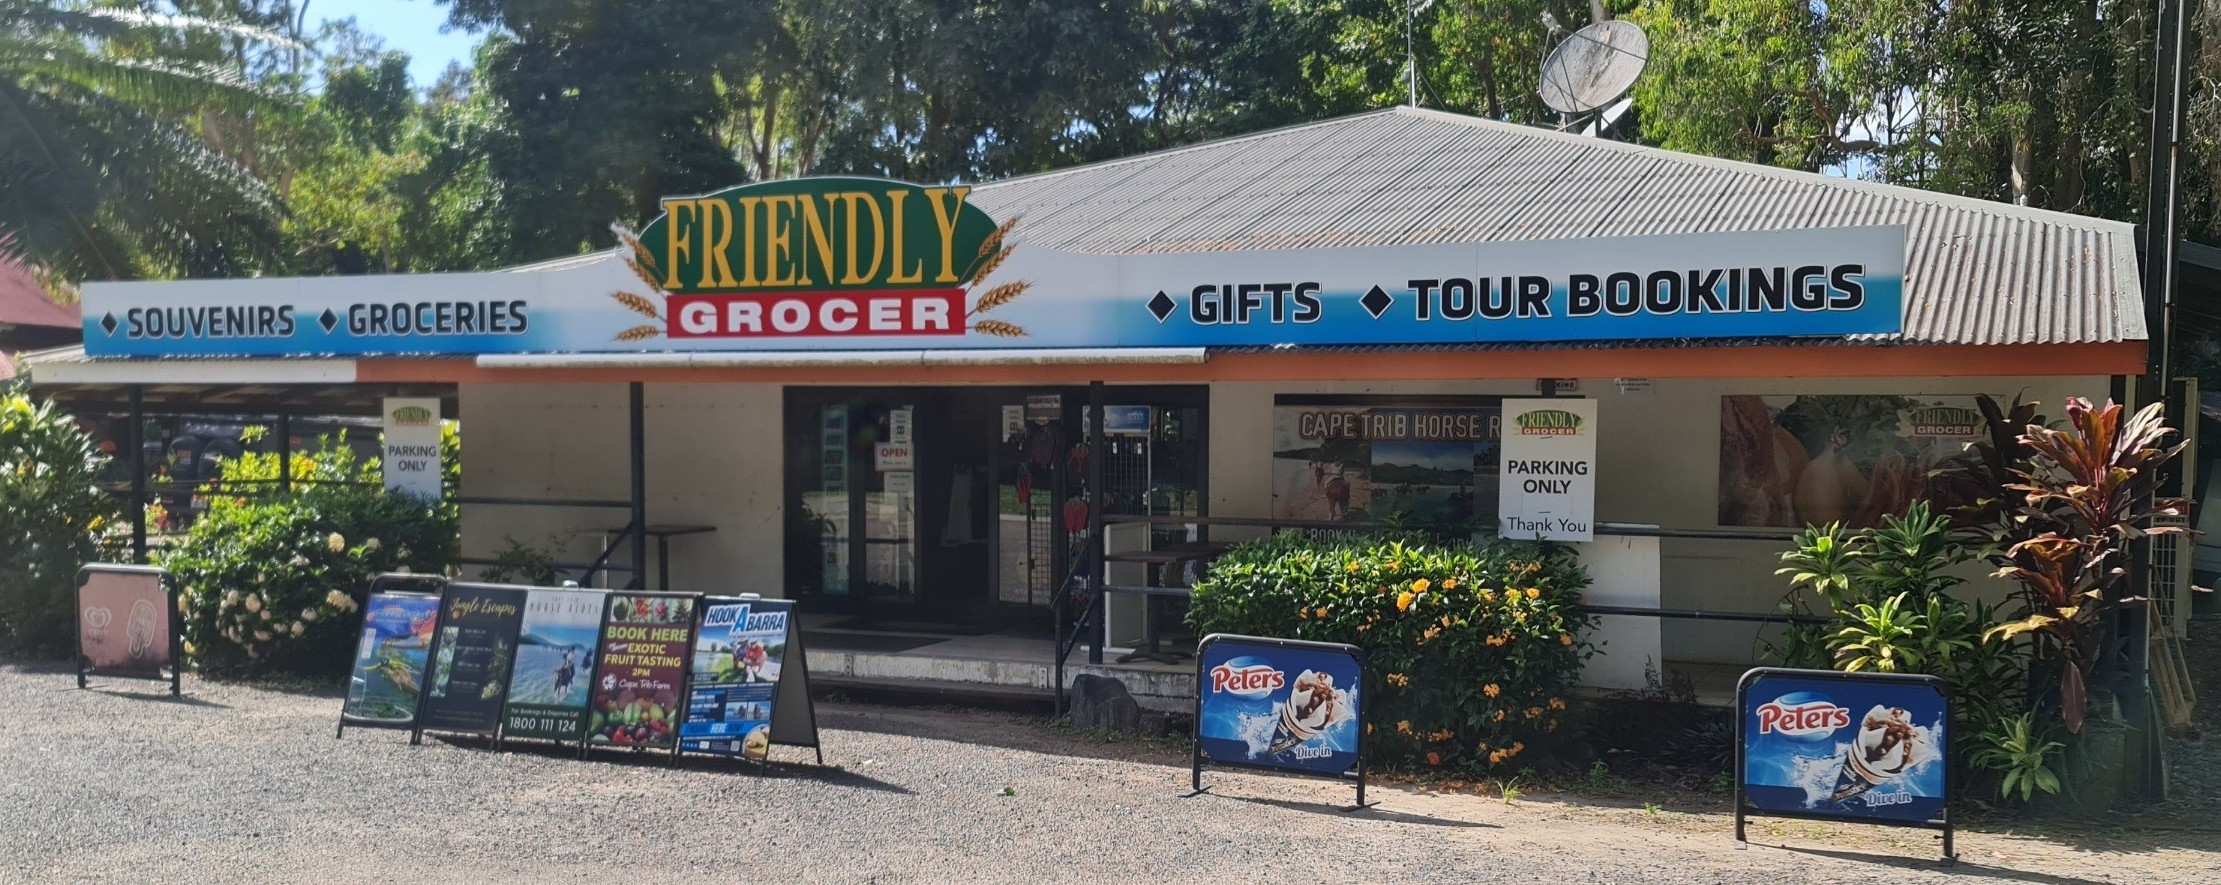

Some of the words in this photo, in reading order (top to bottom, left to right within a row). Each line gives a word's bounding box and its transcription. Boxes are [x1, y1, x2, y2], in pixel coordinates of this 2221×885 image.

[662, 186, 972, 290] FRIENDLY
[1408, 276, 1554, 321] TOUR
[1568, 264, 1866, 317] BOOKINGS
[1190, 281, 1322, 325] GIFTS
[127, 304, 295, 338] SOUVENIRS
[348, 300, 529, 335] GROCERIES
[680, 298, 951, 334] GROCER
[1521, 410, 1578, 428] FRIENDLY
[1915, 408, 1976, 426] FRIENDLY
[1301, 413, 1355, 440] CAPE
[1360, 413, 1407, 440] TRIB
[1413, 413, 1482, 440] HORSE
[1917, 426, 1972, 435] GROCER
[388, 445, 437, 457] PARKING
[881, 448, 908, 457] OPEN
[398, 460, 427, 472] ONLY
[1508, 460, 1588, 475] PARKING
[1523, 479, 1571, 494] ONLY
[1507, 517, 1552, 532] Thank
[1558, 518, 1587, 532] You
[450, 596, 479, 616] Jungle
[481, 598, 518, 618] Escapes
[705, 606, 738, 624] HOOK
[732, 605, 749, 632] A
[746, 613, 786, 632] BARRA
[607, 626, 648, 640] BOOK
[651, 628, 689, 642] HERE
[628, 643, 667, 654] EXOTIC
[604, 654, 636, 666] FRUIT
[637, 655, 681, 667] TASTING
[632, 668, 651, 677] 2PM
[1211, 667, 1285, 692] Peters
[619, 678, 639, 691] Cape
[640, 679, 653, 689] Trib
[653, 680, 671, 690] Farm
[510, 717, 536, 729] 1800
[541, 718, 554, 731] 111
[558, 719, 576, 732] 124
[1757, 704, 1849, 733] Peters
[1296, 746, 1319, 759] Dive
[1319, 745, 1332, 758] in
[1866, 791, 1896, 806] Dive
[1897, 790, 1912, 804] in
